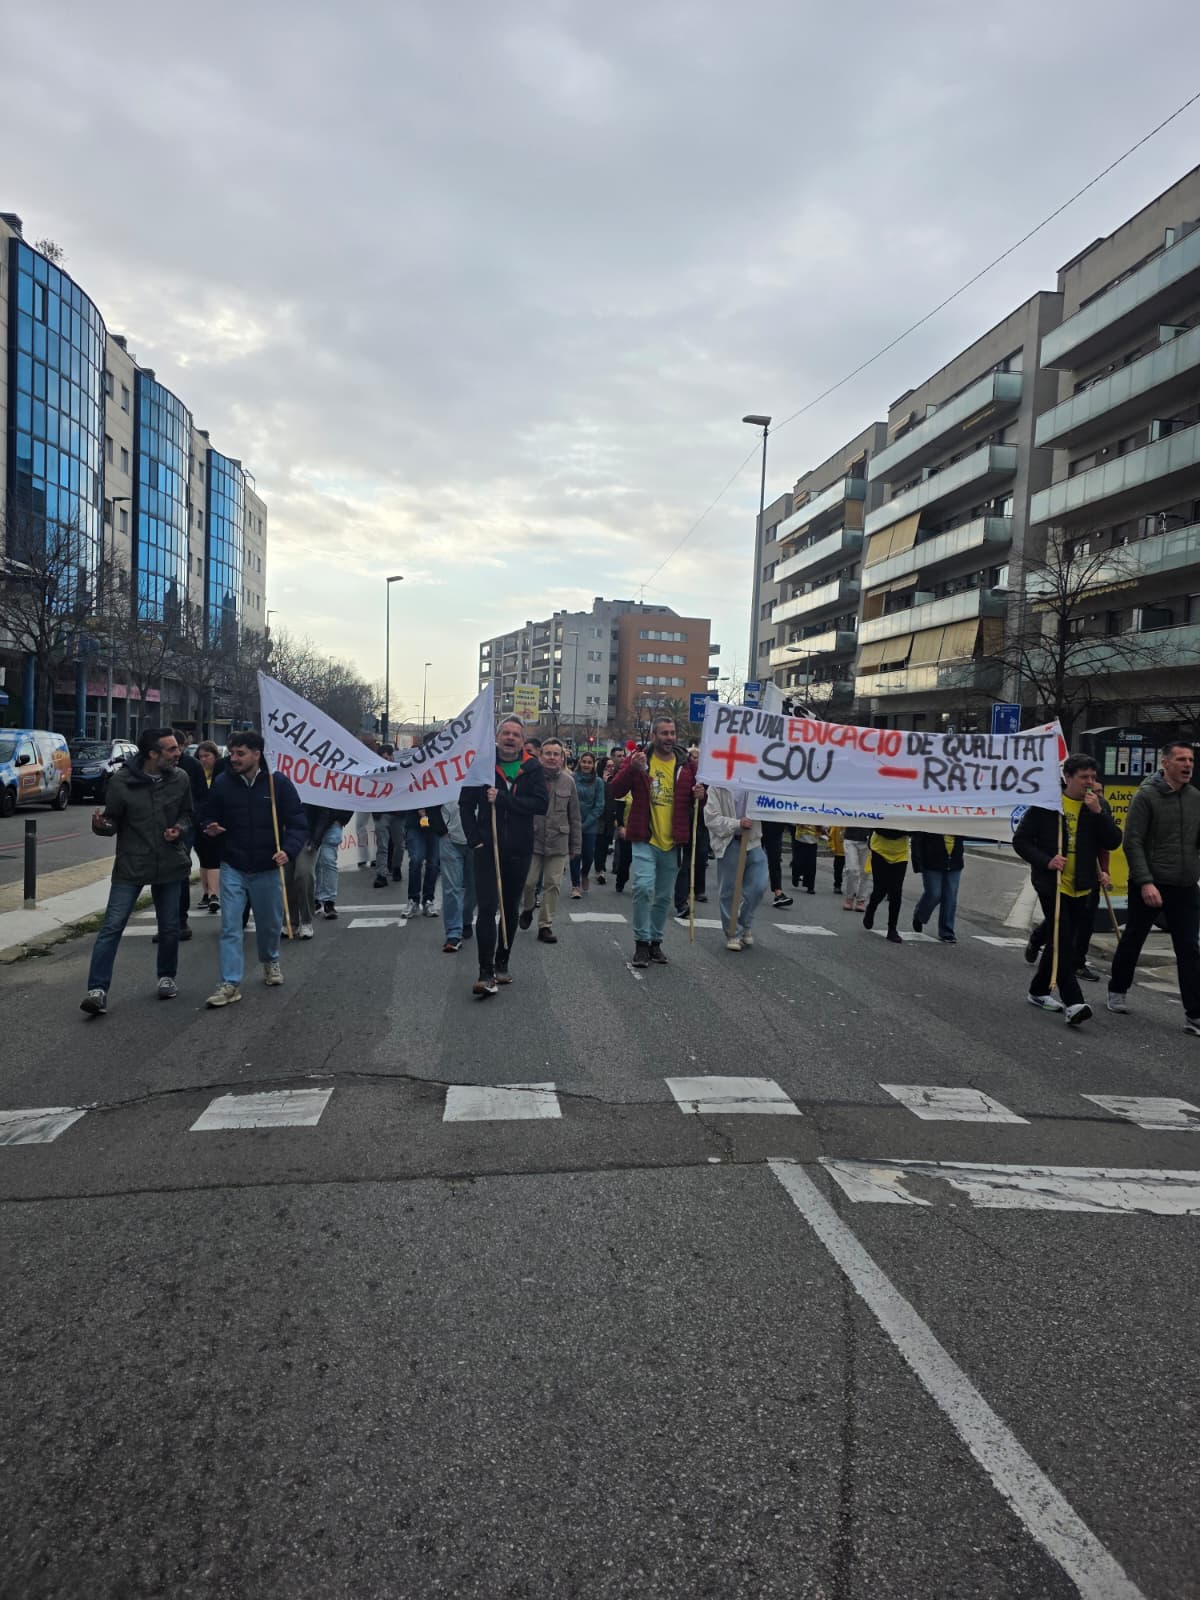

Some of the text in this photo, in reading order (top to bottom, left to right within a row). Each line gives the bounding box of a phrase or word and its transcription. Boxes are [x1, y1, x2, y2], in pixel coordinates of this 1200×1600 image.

[714, 707, 753, 735] PER
[755, 711, 785, 741] UNA
[907, 733, 935, 756] DE
[942, 734, 1053, 762] QUALITAT
[758, 742, 834, 782] SOU
